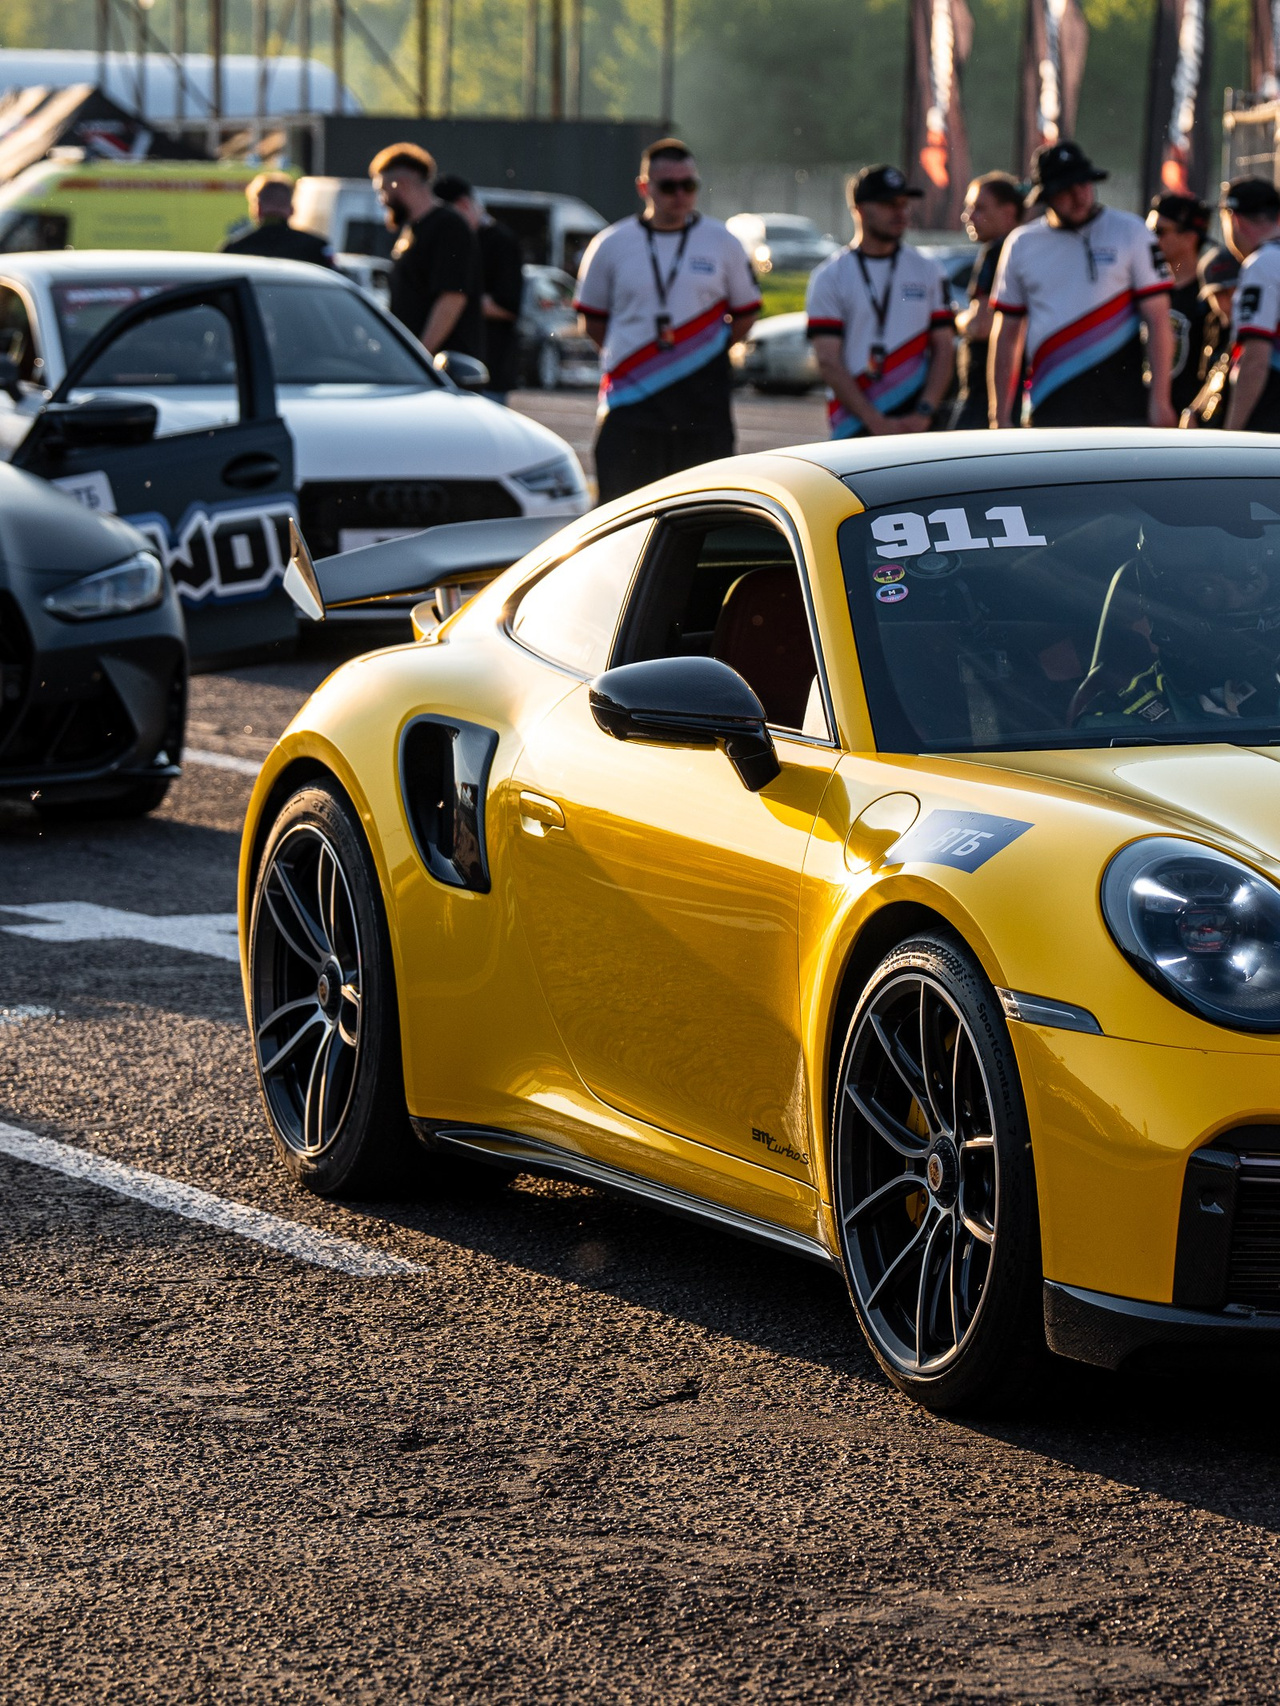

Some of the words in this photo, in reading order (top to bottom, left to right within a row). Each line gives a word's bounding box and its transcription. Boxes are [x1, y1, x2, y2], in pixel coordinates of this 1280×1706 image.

[870, 506, 1047, 559] 911
[925, 827, 995, 857] ВТБ
[976, 1001, 1015, 1124] SportContact
